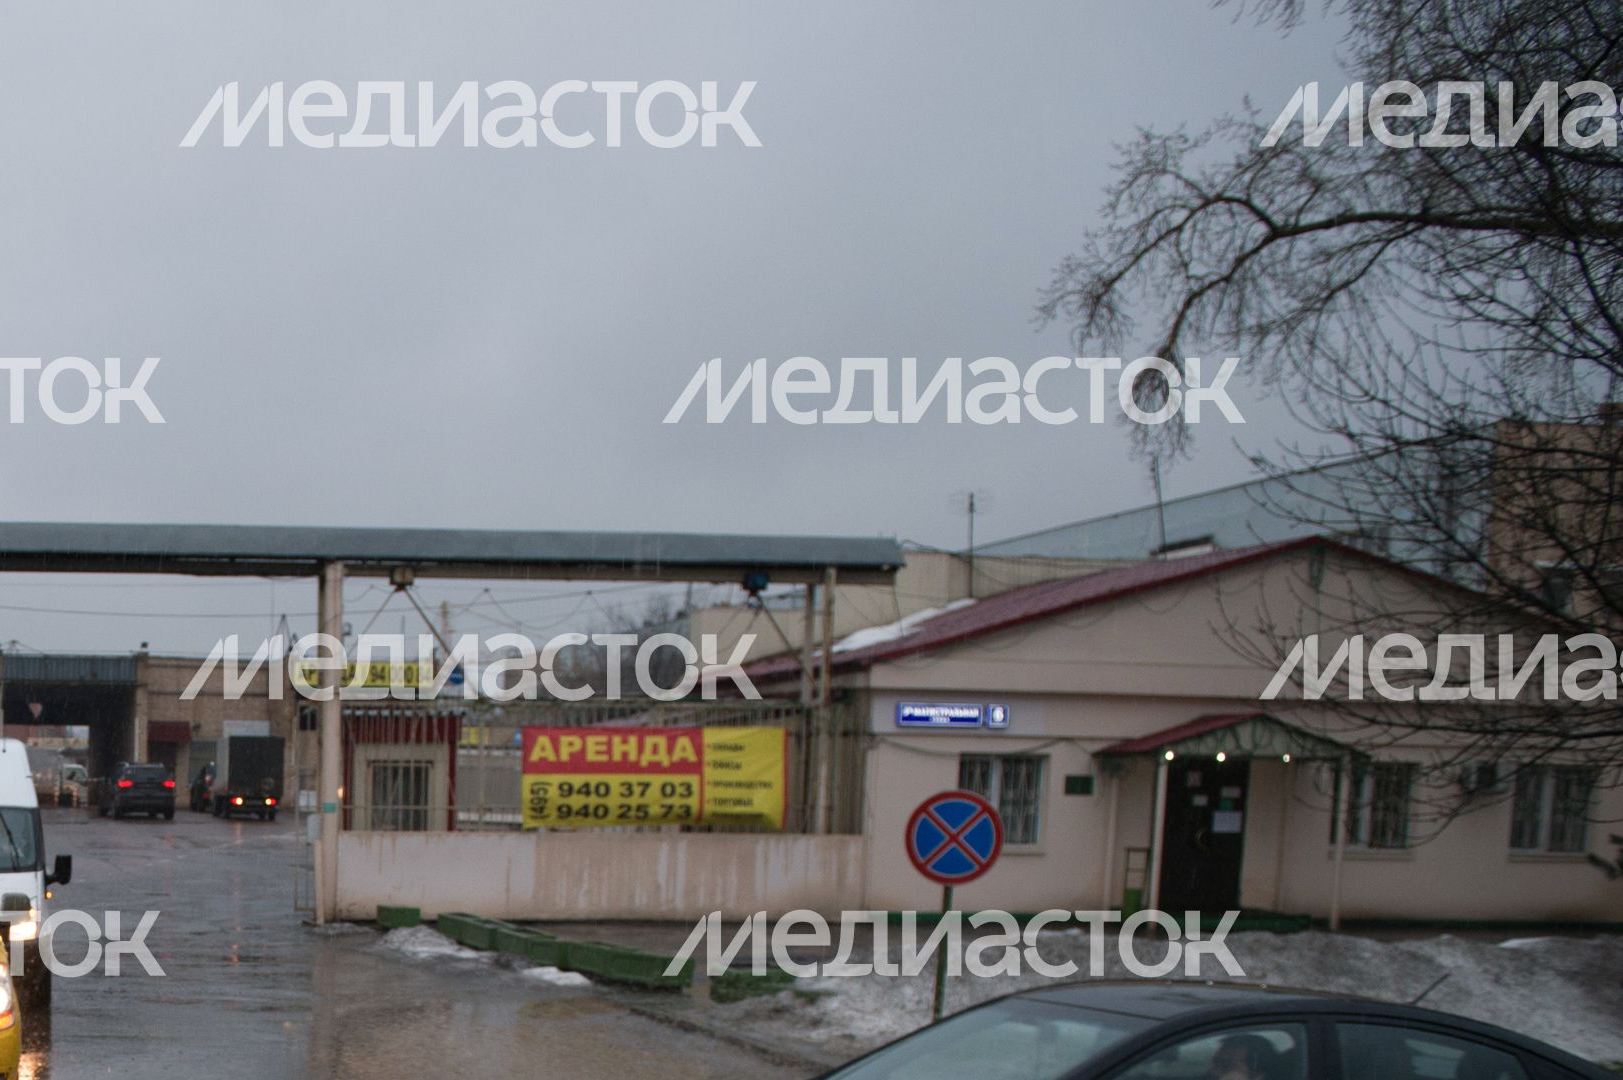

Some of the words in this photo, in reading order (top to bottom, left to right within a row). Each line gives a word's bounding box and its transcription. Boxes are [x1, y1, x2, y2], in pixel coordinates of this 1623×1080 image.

[529, 735, 698, 767] АРЕНДА
[557, 782, 610, 798] 940
[619, 782, 651, 798] 37
[660, 782, 693, 798] 03
[556, 803, 609, 819] 940
[617, 803, 650, 819] 25
[660, 803, 693, 819] 73
